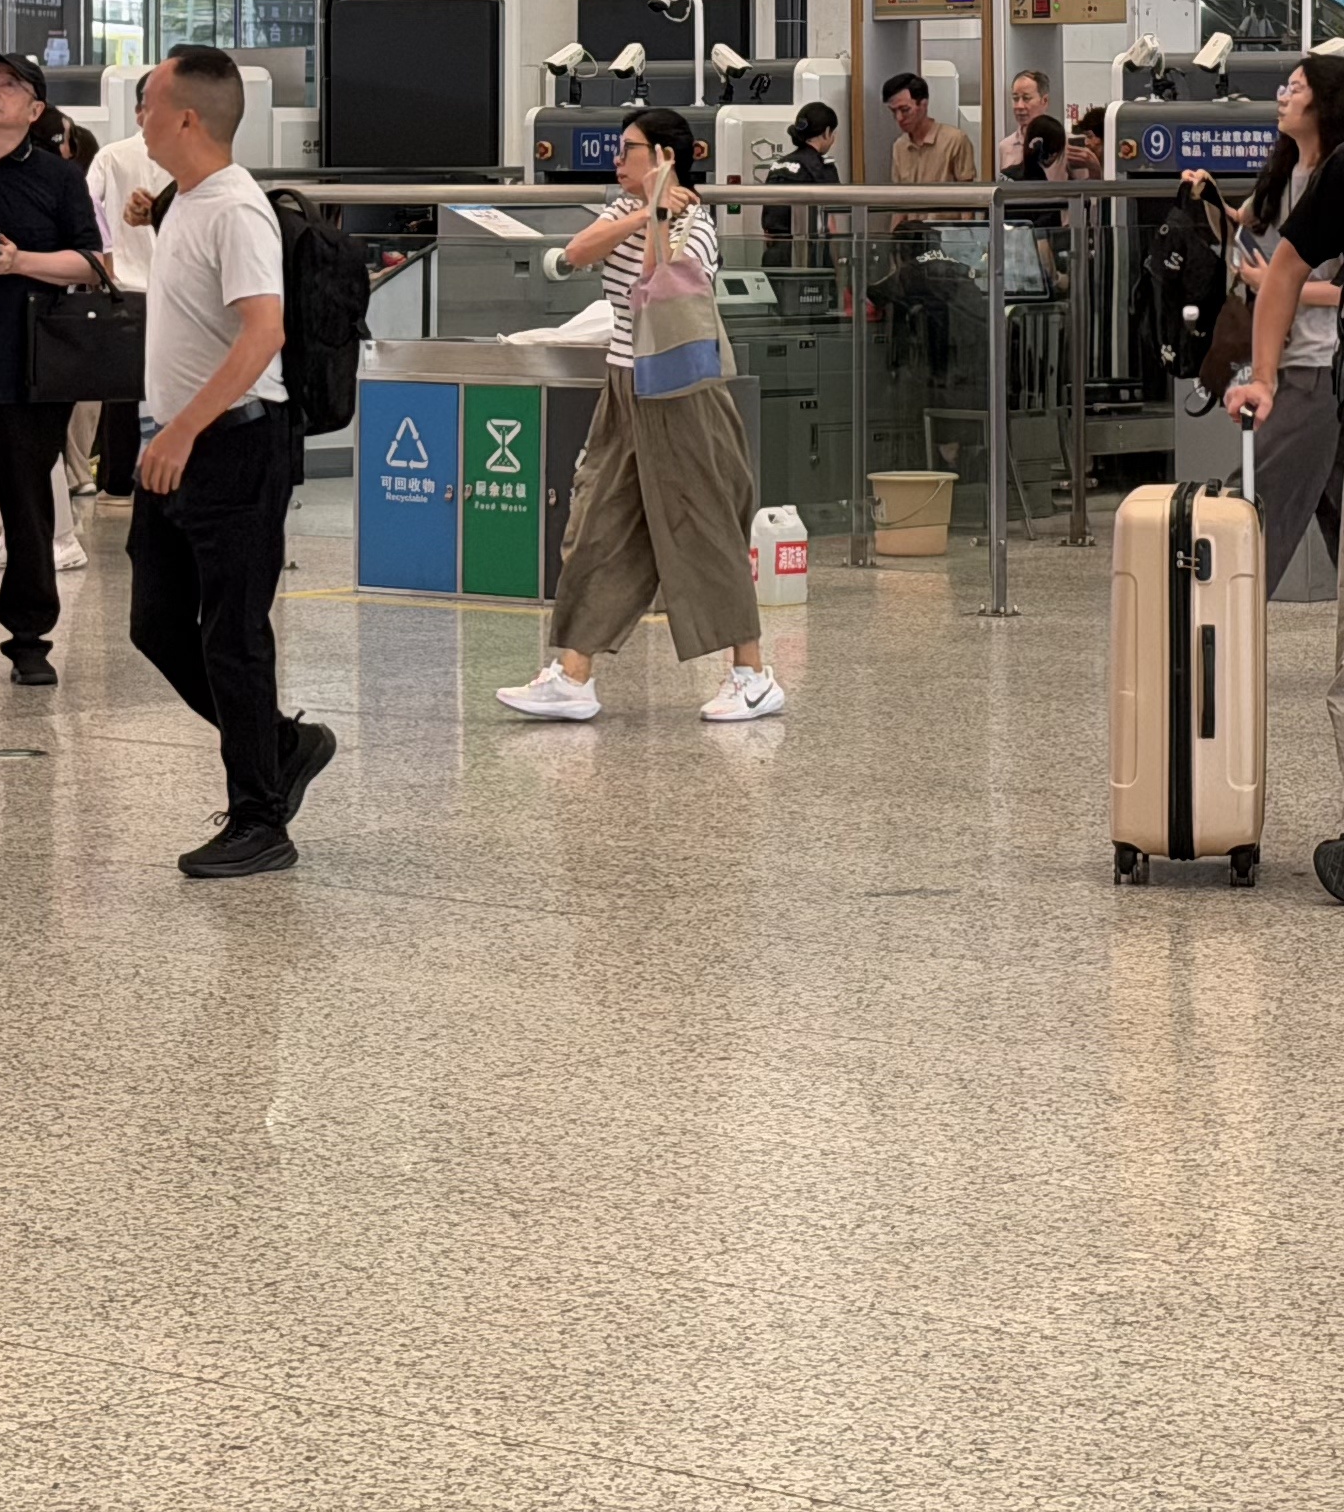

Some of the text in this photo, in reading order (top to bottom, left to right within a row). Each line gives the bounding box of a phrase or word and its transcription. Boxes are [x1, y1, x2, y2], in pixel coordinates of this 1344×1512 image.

[1150, 130, 1164, 155] 9
[1181, 130, 1279, 143] 安检机上故意拿取他
[582, 139, 600, 158] 10
[380, 475, 436, 494] 可回收物
[475, 480, 527, 499] 厨余垃圾
[385, 491, 428, 503] Recyclable
